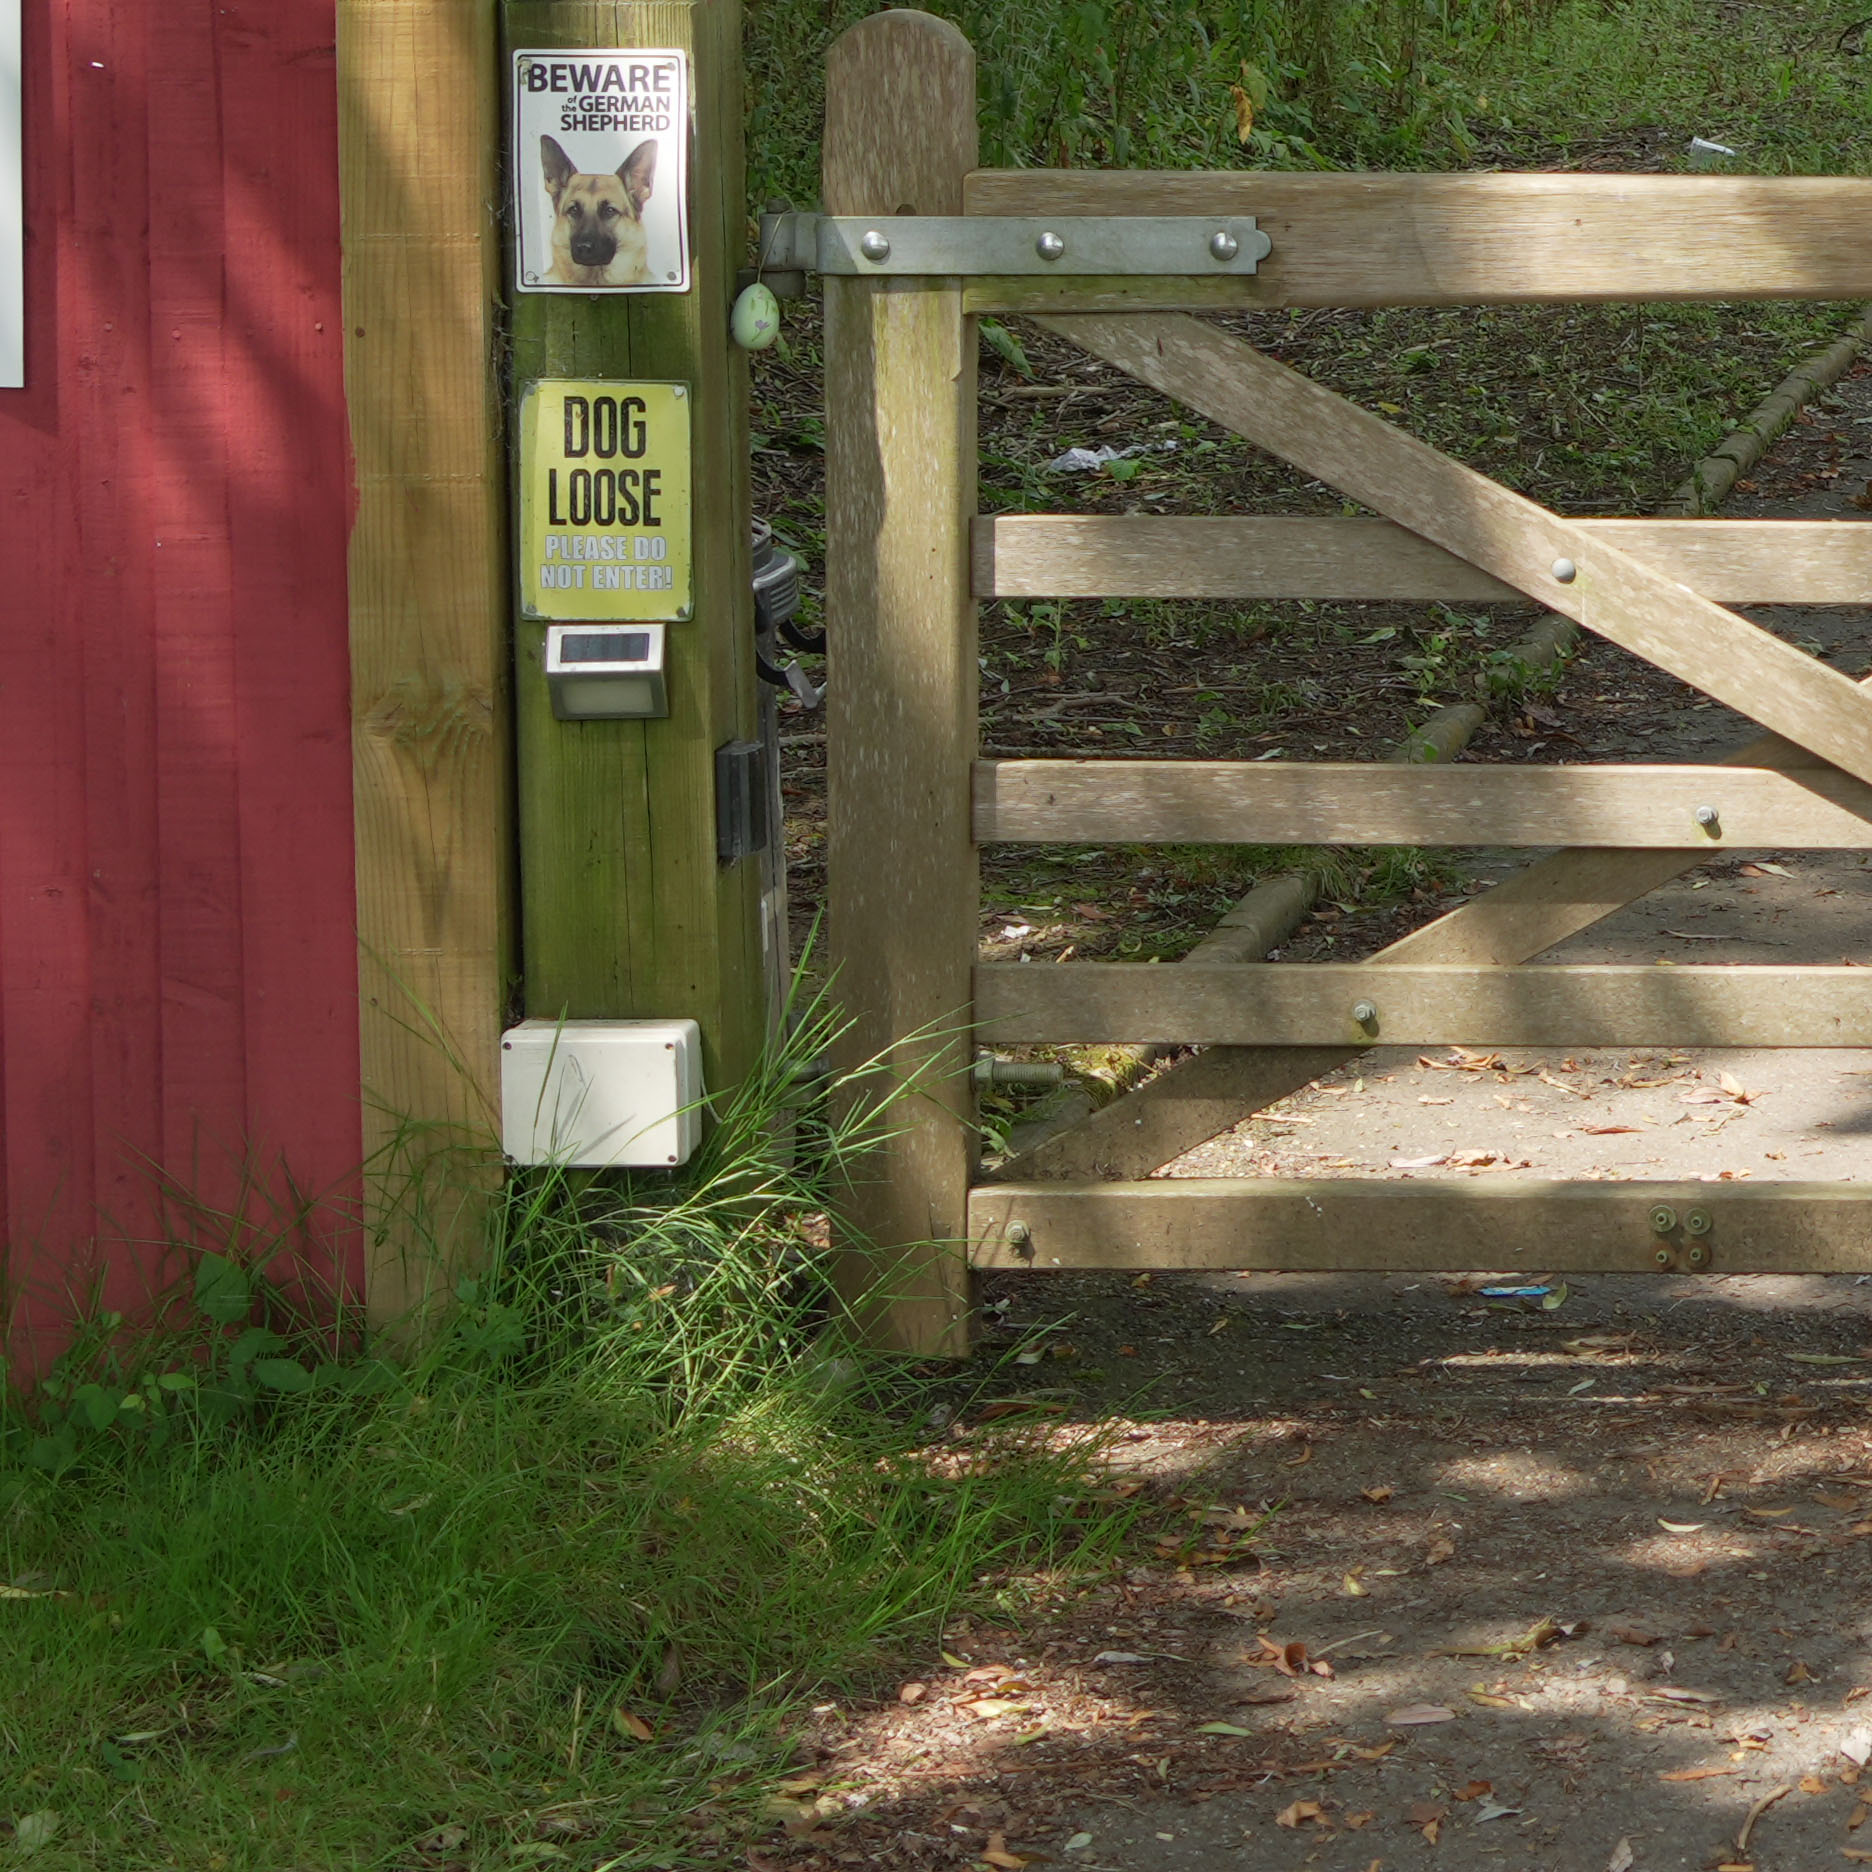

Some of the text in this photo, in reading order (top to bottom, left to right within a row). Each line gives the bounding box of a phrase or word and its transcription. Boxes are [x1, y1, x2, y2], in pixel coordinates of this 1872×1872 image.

[528, 64, 671, 92] BEWARE
[568, 96, 577, 104] of
[578, 95, 671, 113] GERMAN
[560, 114, 671, 131] SHEPHERD
[563, 396, 647, 459] DOG
[548, 468, 662, 527] LOOSE
[545, 535, 667, 561] PLEASE DO
[540, 564, 673, 590] NOT ENTER!
